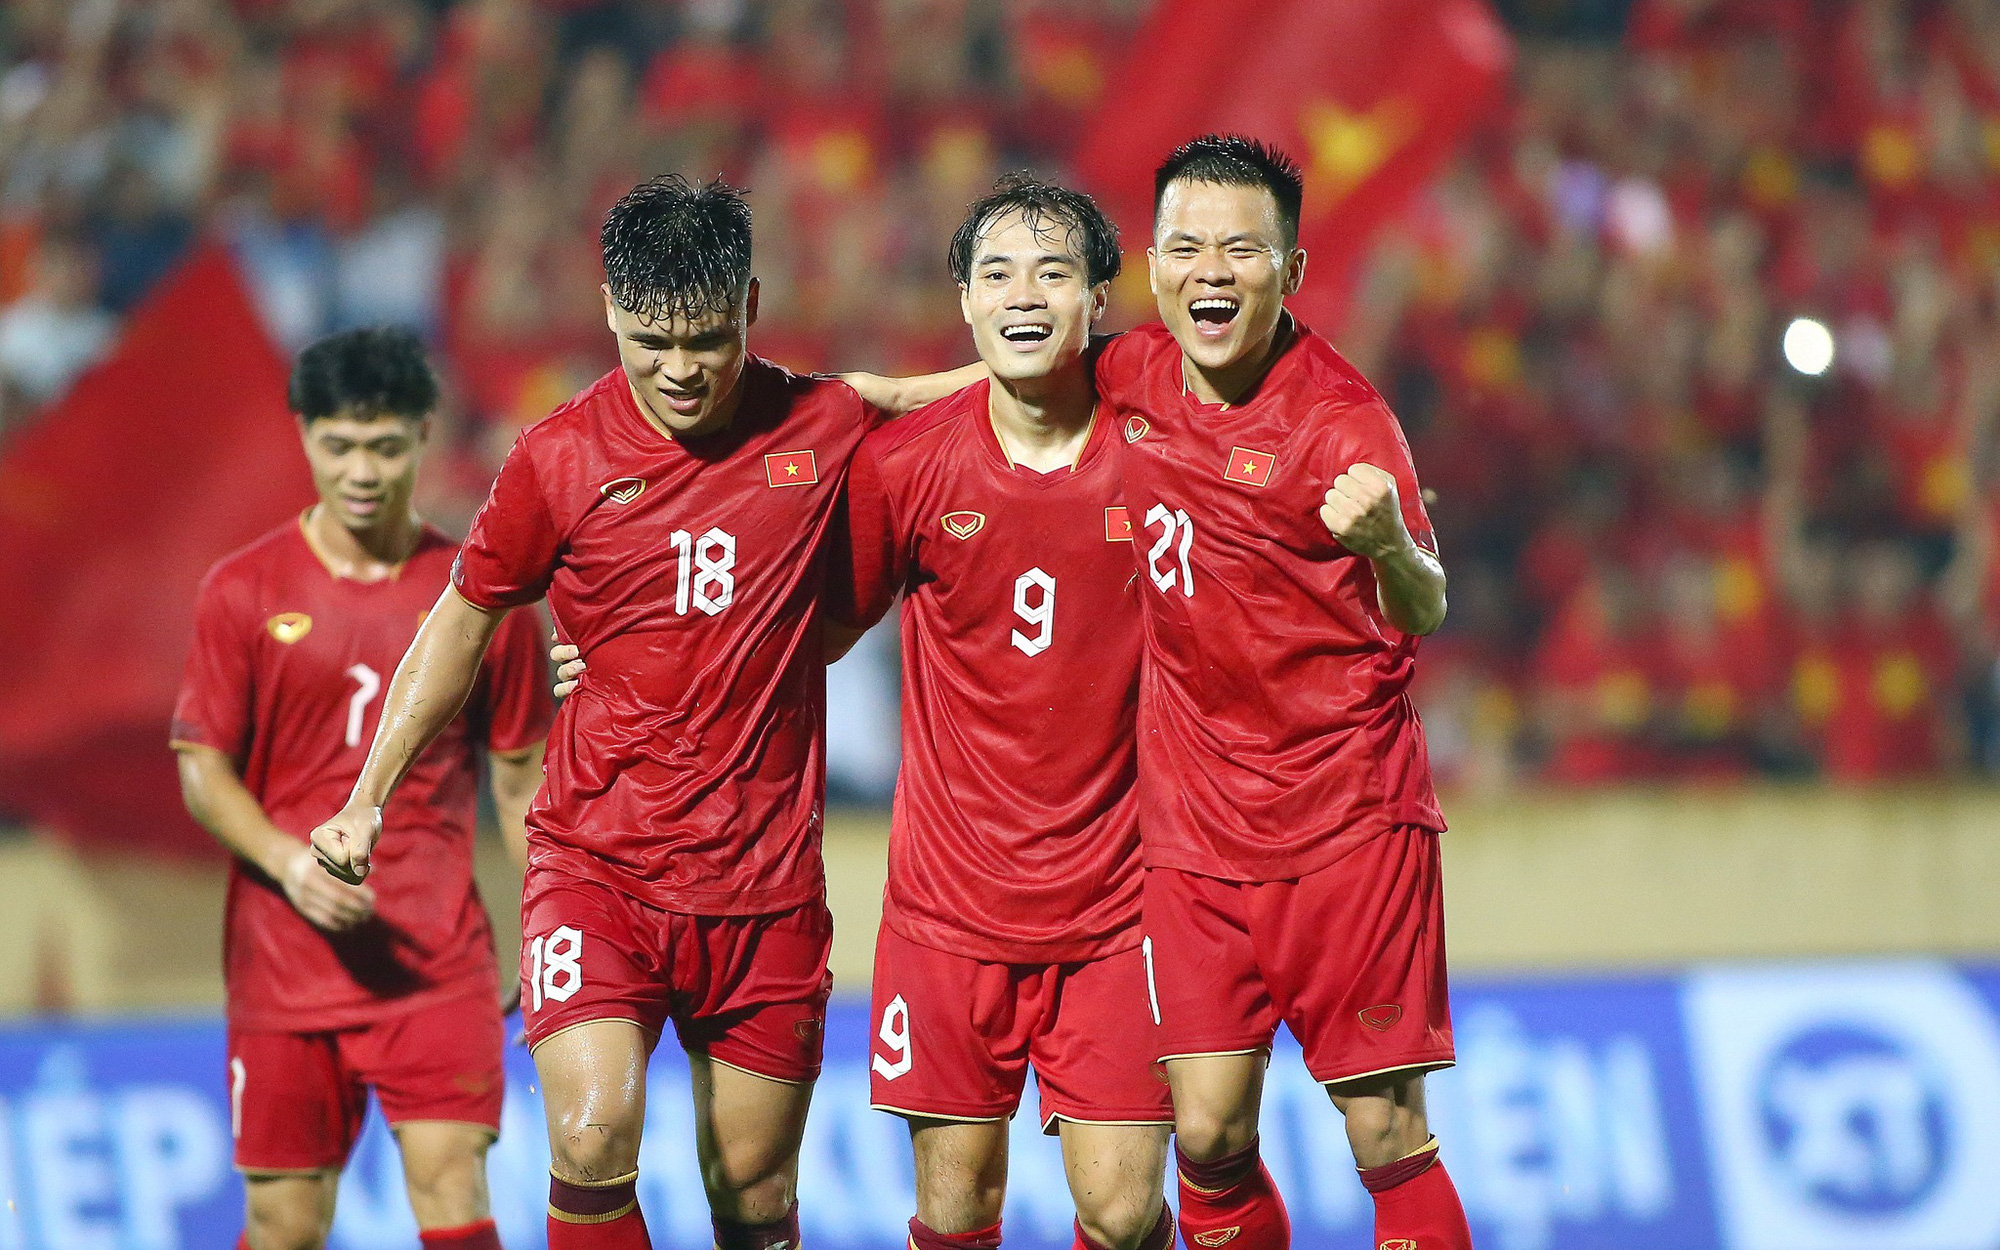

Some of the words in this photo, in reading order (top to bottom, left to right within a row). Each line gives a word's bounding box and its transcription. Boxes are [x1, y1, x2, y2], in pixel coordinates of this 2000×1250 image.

[670, 526, 736, 617] 18
[1143, 502, 1194, 598] 21
[1011, 566, 1056, 658] 9
[345, 663, 381, 748] 7
[529, 925, 583, 1013] 18
[1142, 934, 1162, 1026] 1
[871, 992, 913, 1082] 9
